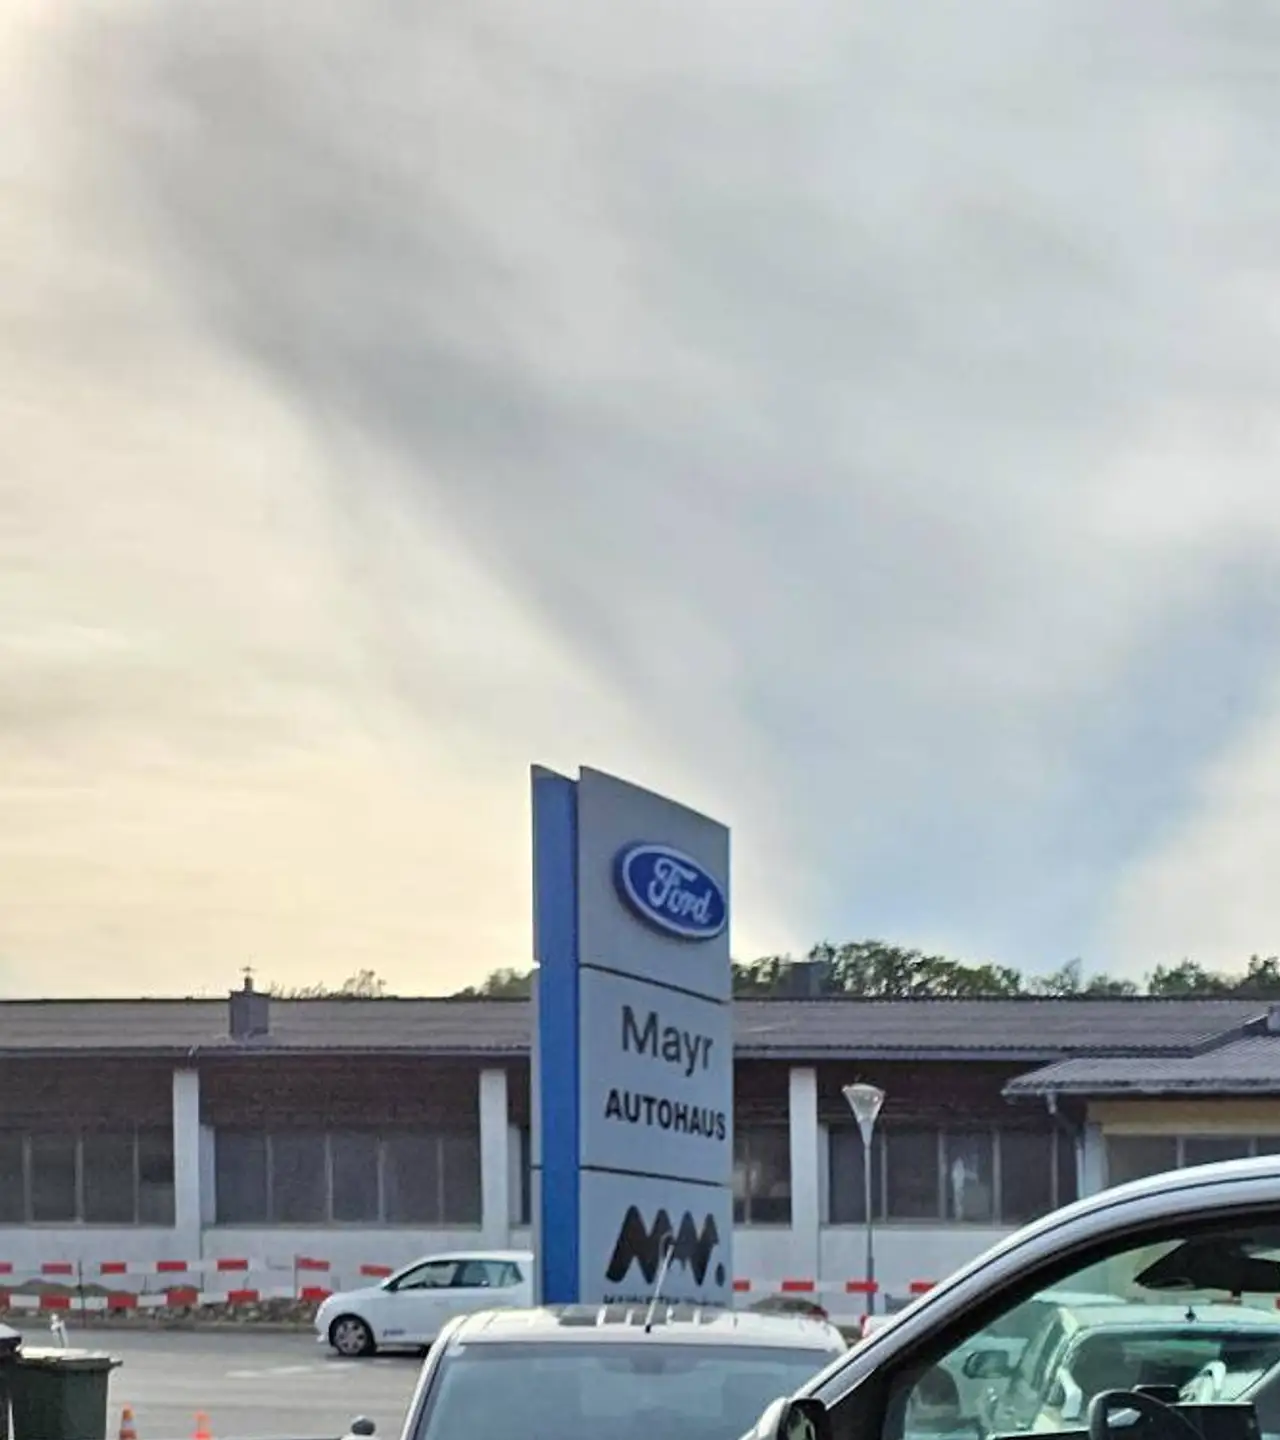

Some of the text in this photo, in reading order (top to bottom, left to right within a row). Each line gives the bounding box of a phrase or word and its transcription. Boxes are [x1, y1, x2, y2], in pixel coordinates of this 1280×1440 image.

[647, 856, 712, 925] Ford
[622, 1005, 714, 1077] Mayr
[605, 1089, 726, 1141] AUTOHAUS
